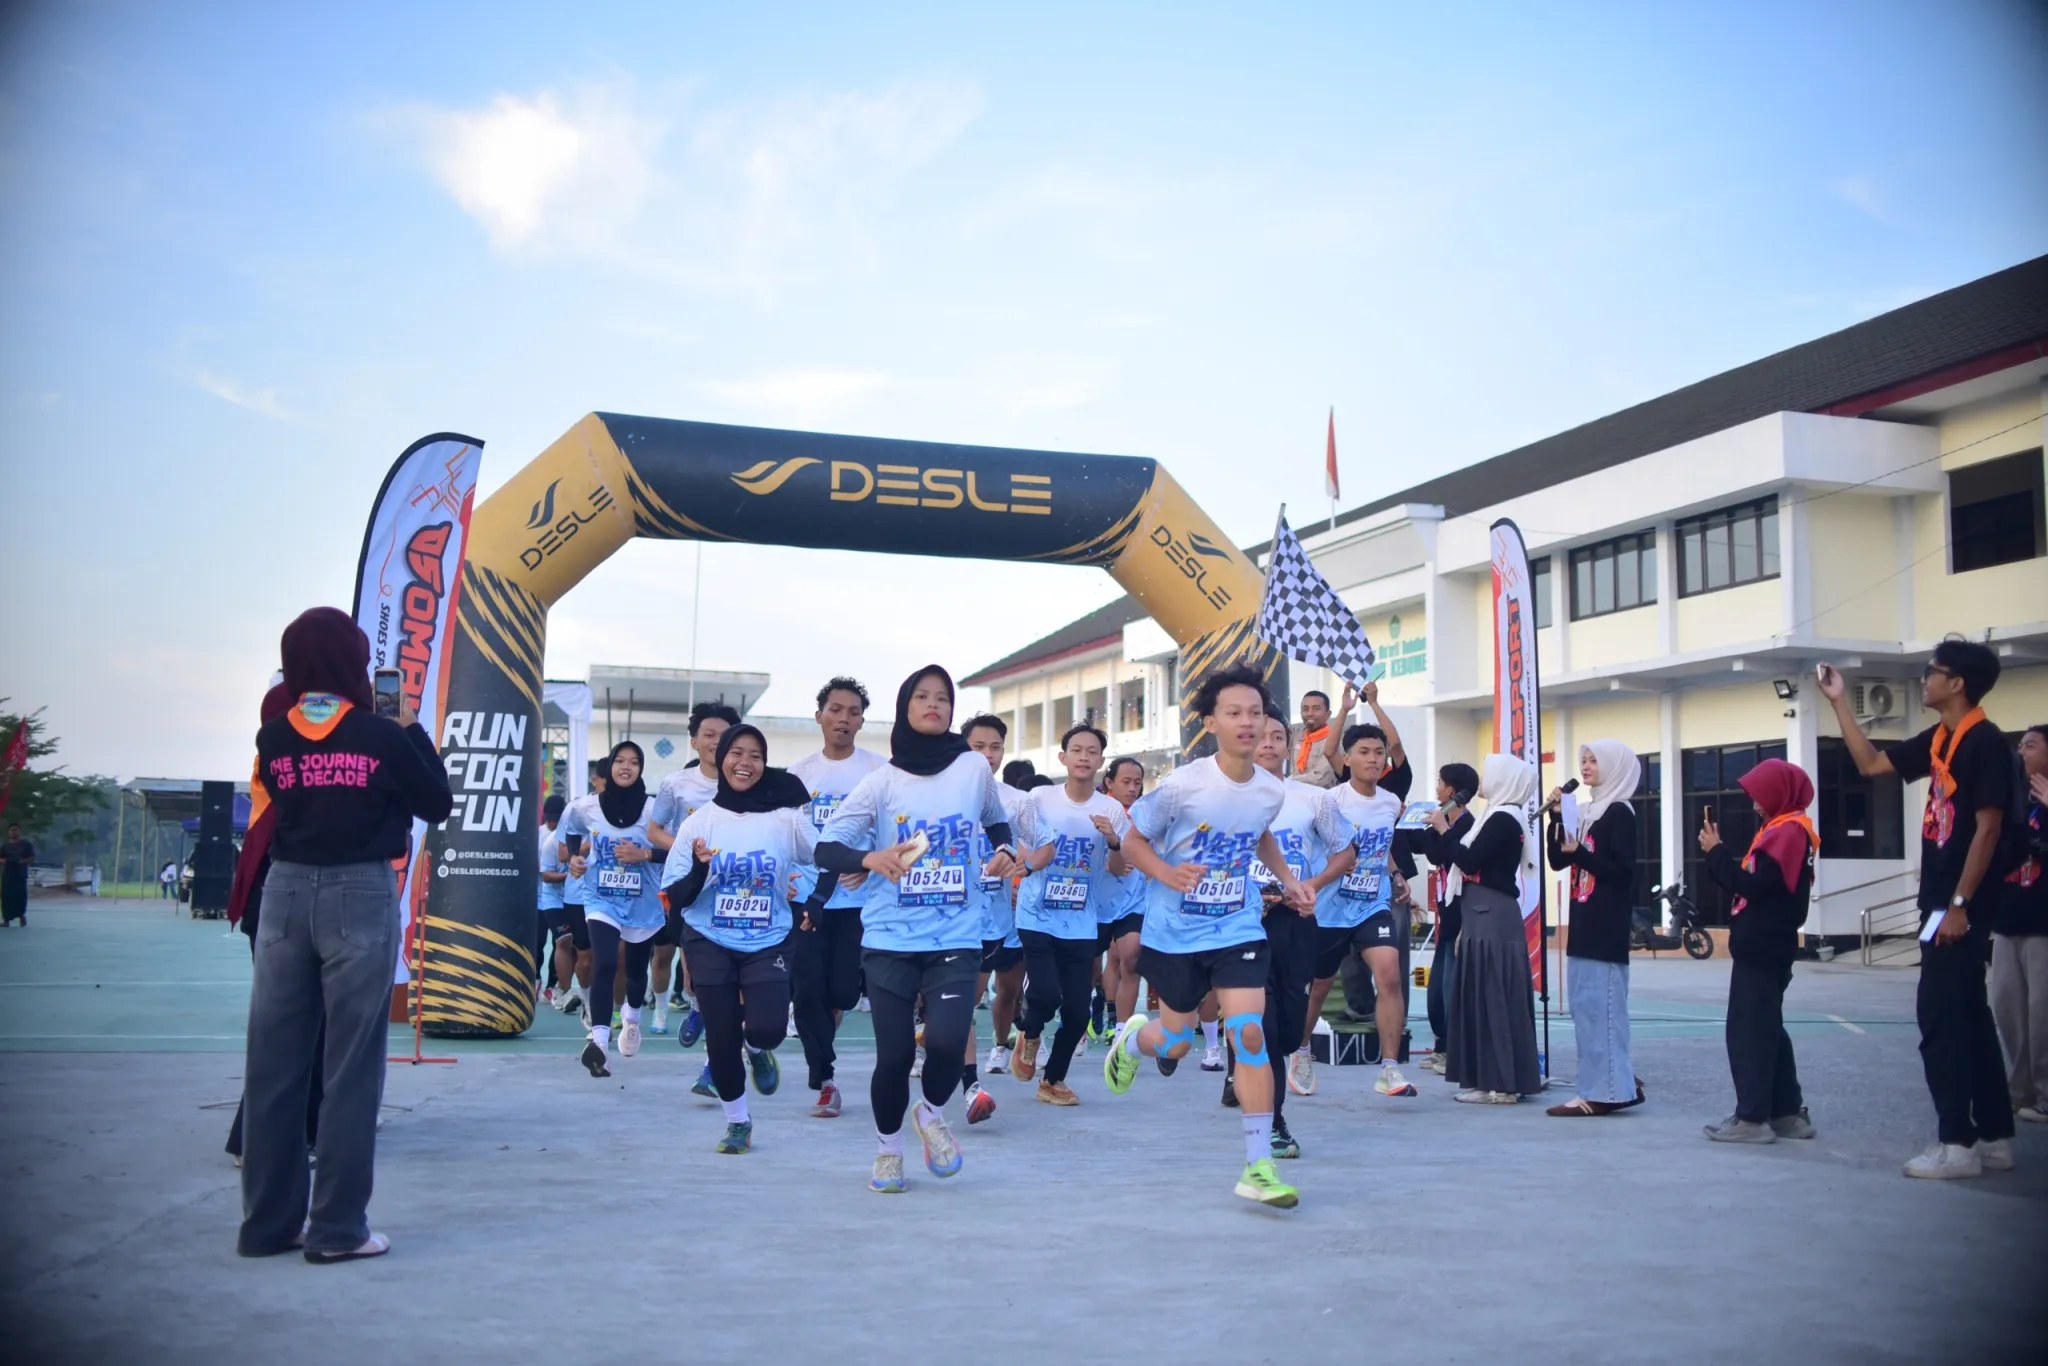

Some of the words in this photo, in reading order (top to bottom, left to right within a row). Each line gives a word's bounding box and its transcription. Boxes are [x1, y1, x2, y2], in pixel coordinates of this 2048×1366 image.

[830, 460, 1052, 515] DESLE
[519, 485, 614, 571] DESLE
[1150, 525, 1232, 611] DESLE
[377, 602, 390, 647] SHOES
[441, 711, 527, 750] RUN
[298, 753, 380, 774] JOURNEY
[444, 752, 523, 791] FOR
[277, 772, 296, 790] OF
[302, 769, 367, 788] DECADE
[458, 851, 514, 860] @DESLESHOES
[450, 867, 519, 876] DESLESHOES.CO.ID
[602, 873, 632, 884] 10507
[905, 870, 951, 886] 10524
[1049, 884, 1079, 897] 10546
[1192, 881, 1234, 897] 10510
[1347, 875, 1374, 888] 10517
[720, 897, 759, 912] 10502
